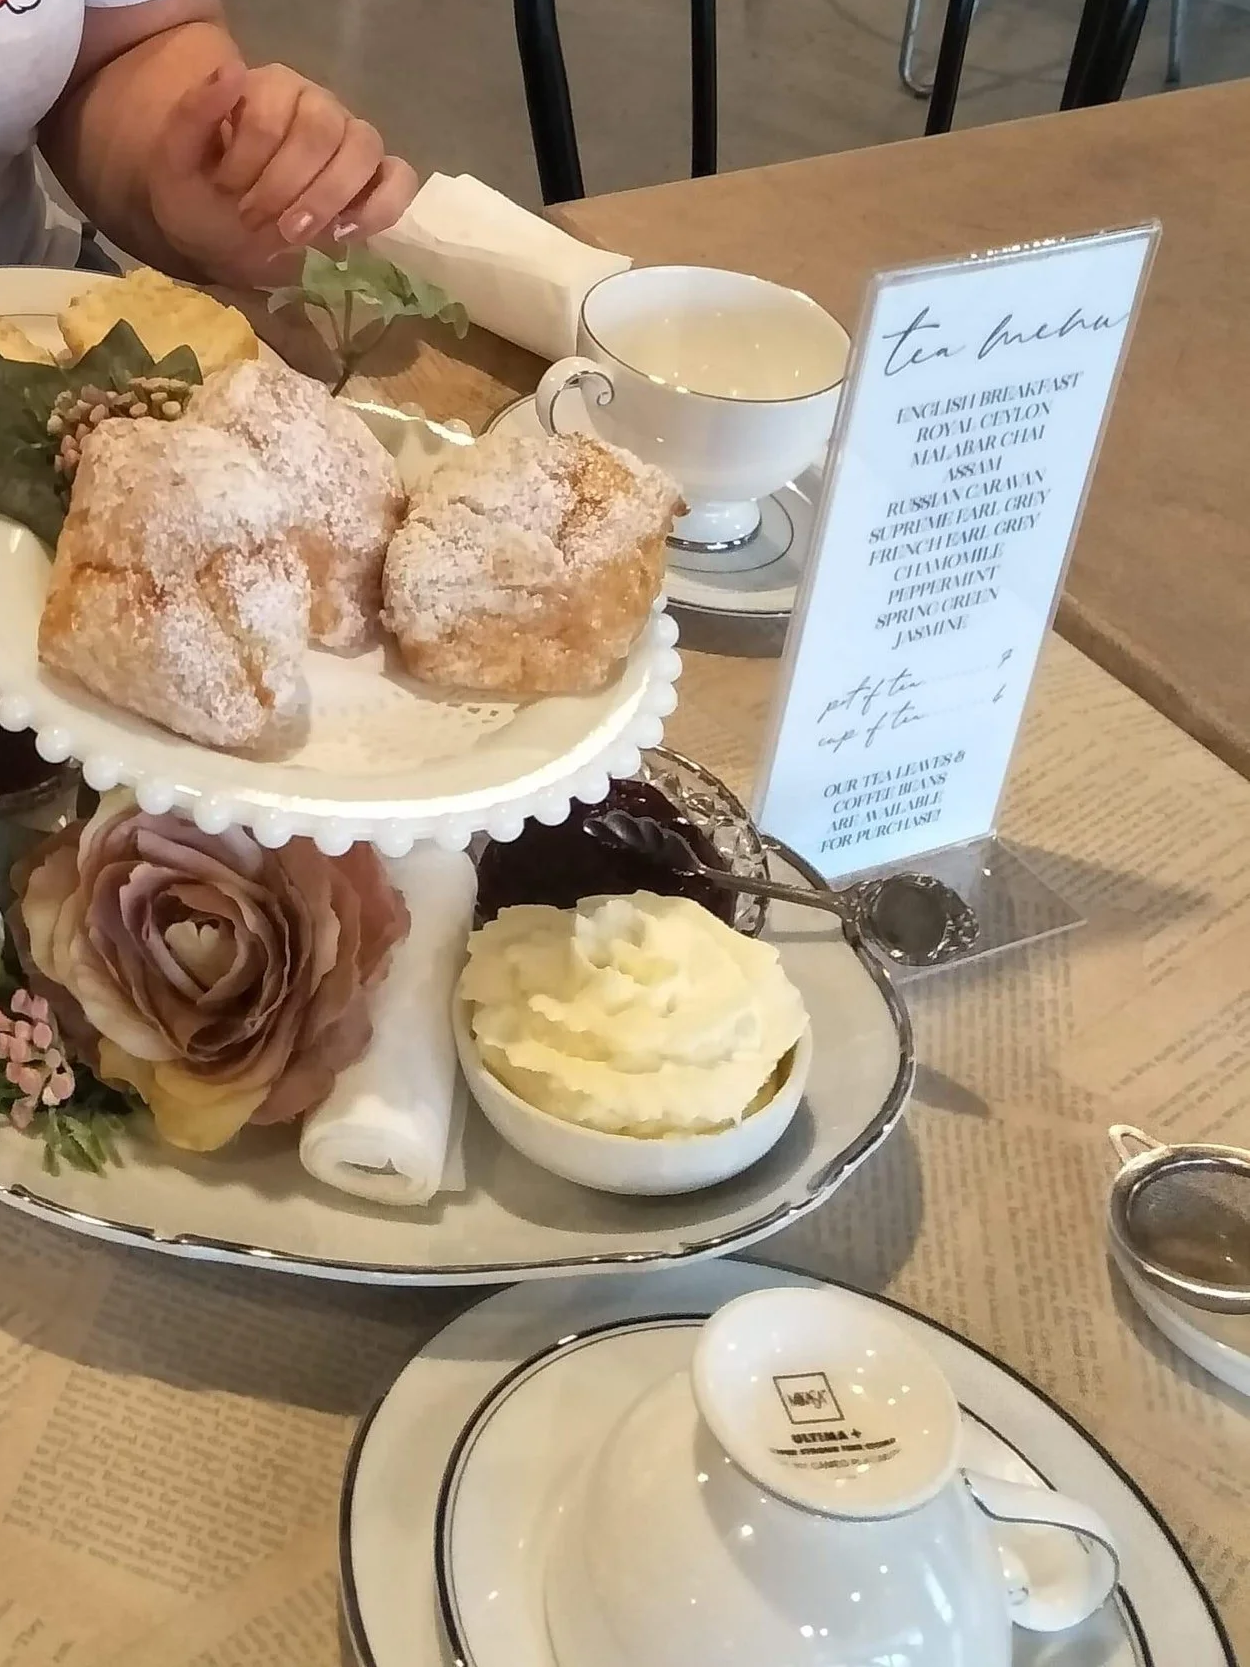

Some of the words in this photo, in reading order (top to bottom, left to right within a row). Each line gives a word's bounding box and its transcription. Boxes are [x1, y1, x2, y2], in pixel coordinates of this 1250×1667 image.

[882, 306, 966, 376] tea
[977, 308, 1129, 360] menu
[896, 391, 976, 424] ENGLISH
[979, 371, 1084, 407] BREAKFAST
[915, 416, 975, 444] ROYAL
[980, 399, 1053, 429] CEYLON
[911, 434, 998, 468] MALABAR
[1000, 424, 1045, 448] CHAI
[943, 455, 1002, 482] ASSAM
[886, 488, 961, 518] RUSSIAN
[965, 467, 1047, 500] CARAVAN
[868, 512, 954, 545] SUPREME
[955, 502, 1000, 525] EARL
[1004, 489, 1051, 512] GREY
[868, 535, 943, 566] FRENCH
[945, 525, 990, 548] EARL
[994, 512, 1041, 535] GREY
[887, 565, 1001, 605] PEPPERMINT
[893, 543, 1005, 582] CHAMOMILE
[875, 600, 939, 630] SPRING
[941, 587, 1000, 613] GREEN
[892, 614, 969, 650] JASMINE
[817, 676, 872, 723] pot
[862, 679, 885, 716] of
[888, 668, 926, 697] tea
[818, 729, 857, 753] cup
[865, 712, 888, 748] of
[891, 701, 928, 729] tea
[824, 778, 858, 798] OUR
[863, 768, 892, 788] TEA
[896, 752, 952, 780] LEAVES
[953, 750, 966, 763] &
[833, 787, 895, 814] COFFEE
[898, 772, 948, 796] BEANS
[820, 833, 854, 853] FOR
[856, 808, 942, 844] PURCHASE!
[828, 814, 859, 834] ARE
[865, 790, 944, 823] AVAILABLE
